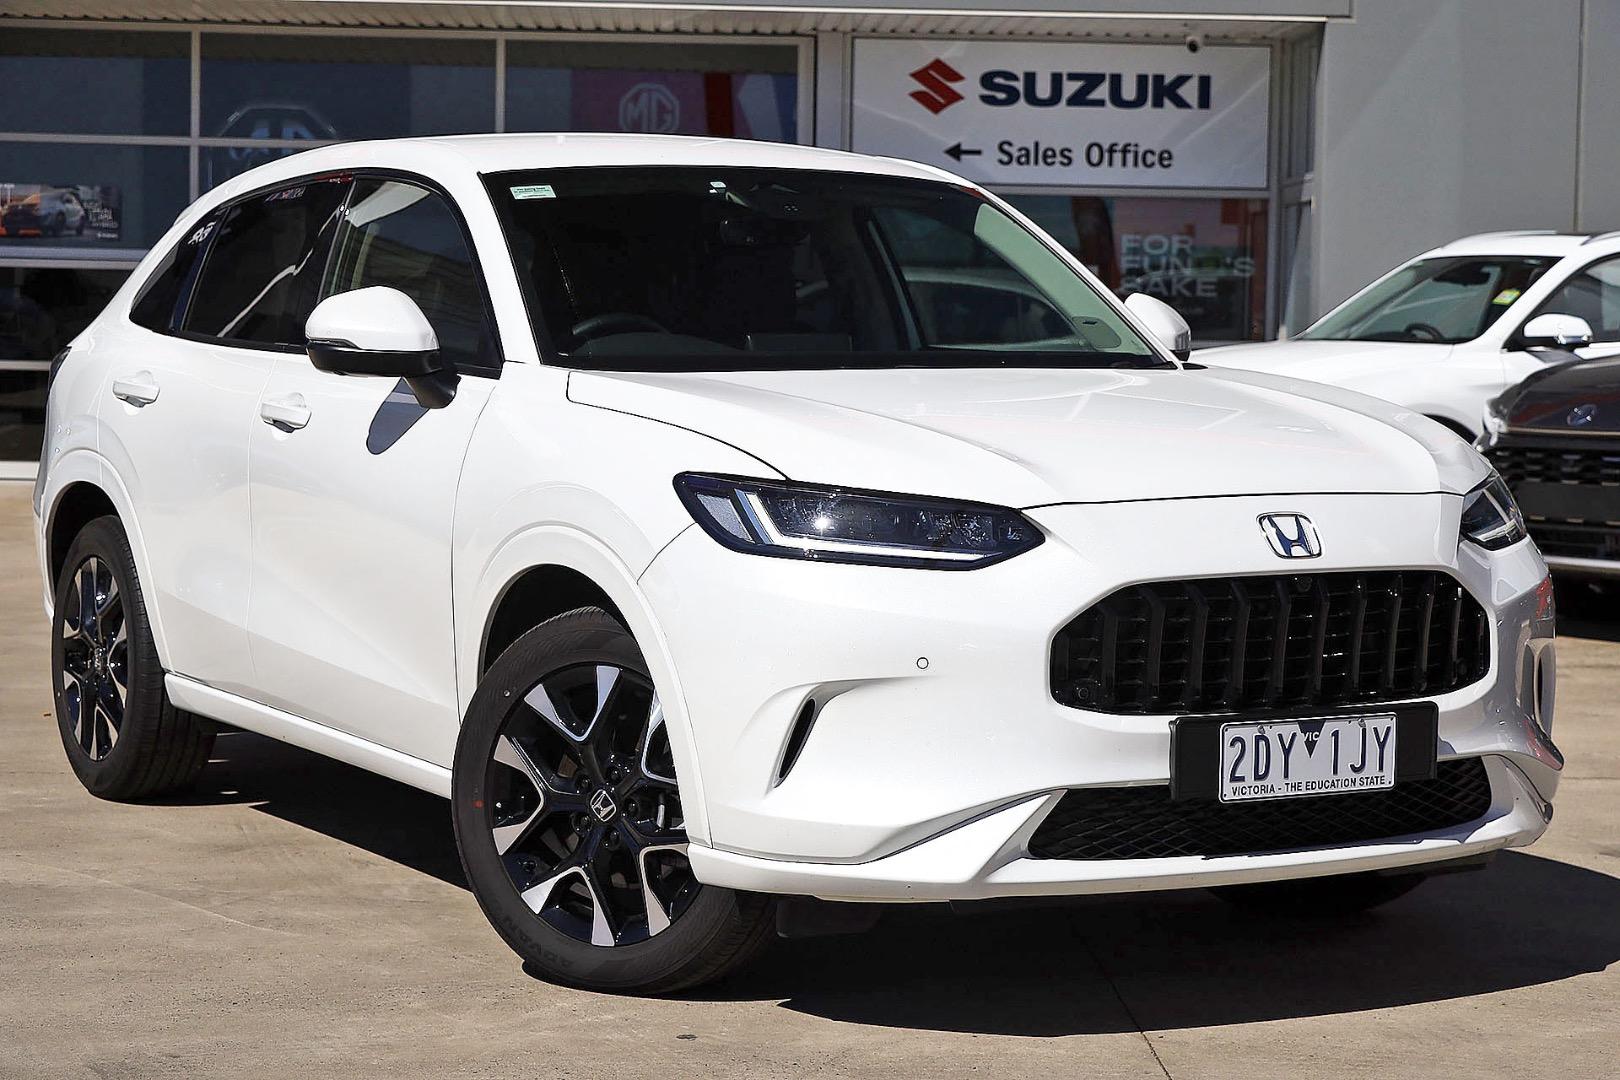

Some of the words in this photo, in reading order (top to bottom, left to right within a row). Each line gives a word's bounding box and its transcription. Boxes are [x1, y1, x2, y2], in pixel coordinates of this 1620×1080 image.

[978, 70, 1211, 109] SUZUKI
[997, 140, 1073, 166] Sales
[1085, 142, 1174, 168] Office
[1121, 234, 1193, 255] FOR
[1303, 731, 1320, 741] VIC
[1231, 783, 1275, 796] VICTORIA
[1285, 781, 1302, 792] THE
[1305, 777, 1357, 791] EDUCATION
[1358, 775, 1386, 787] STATE
